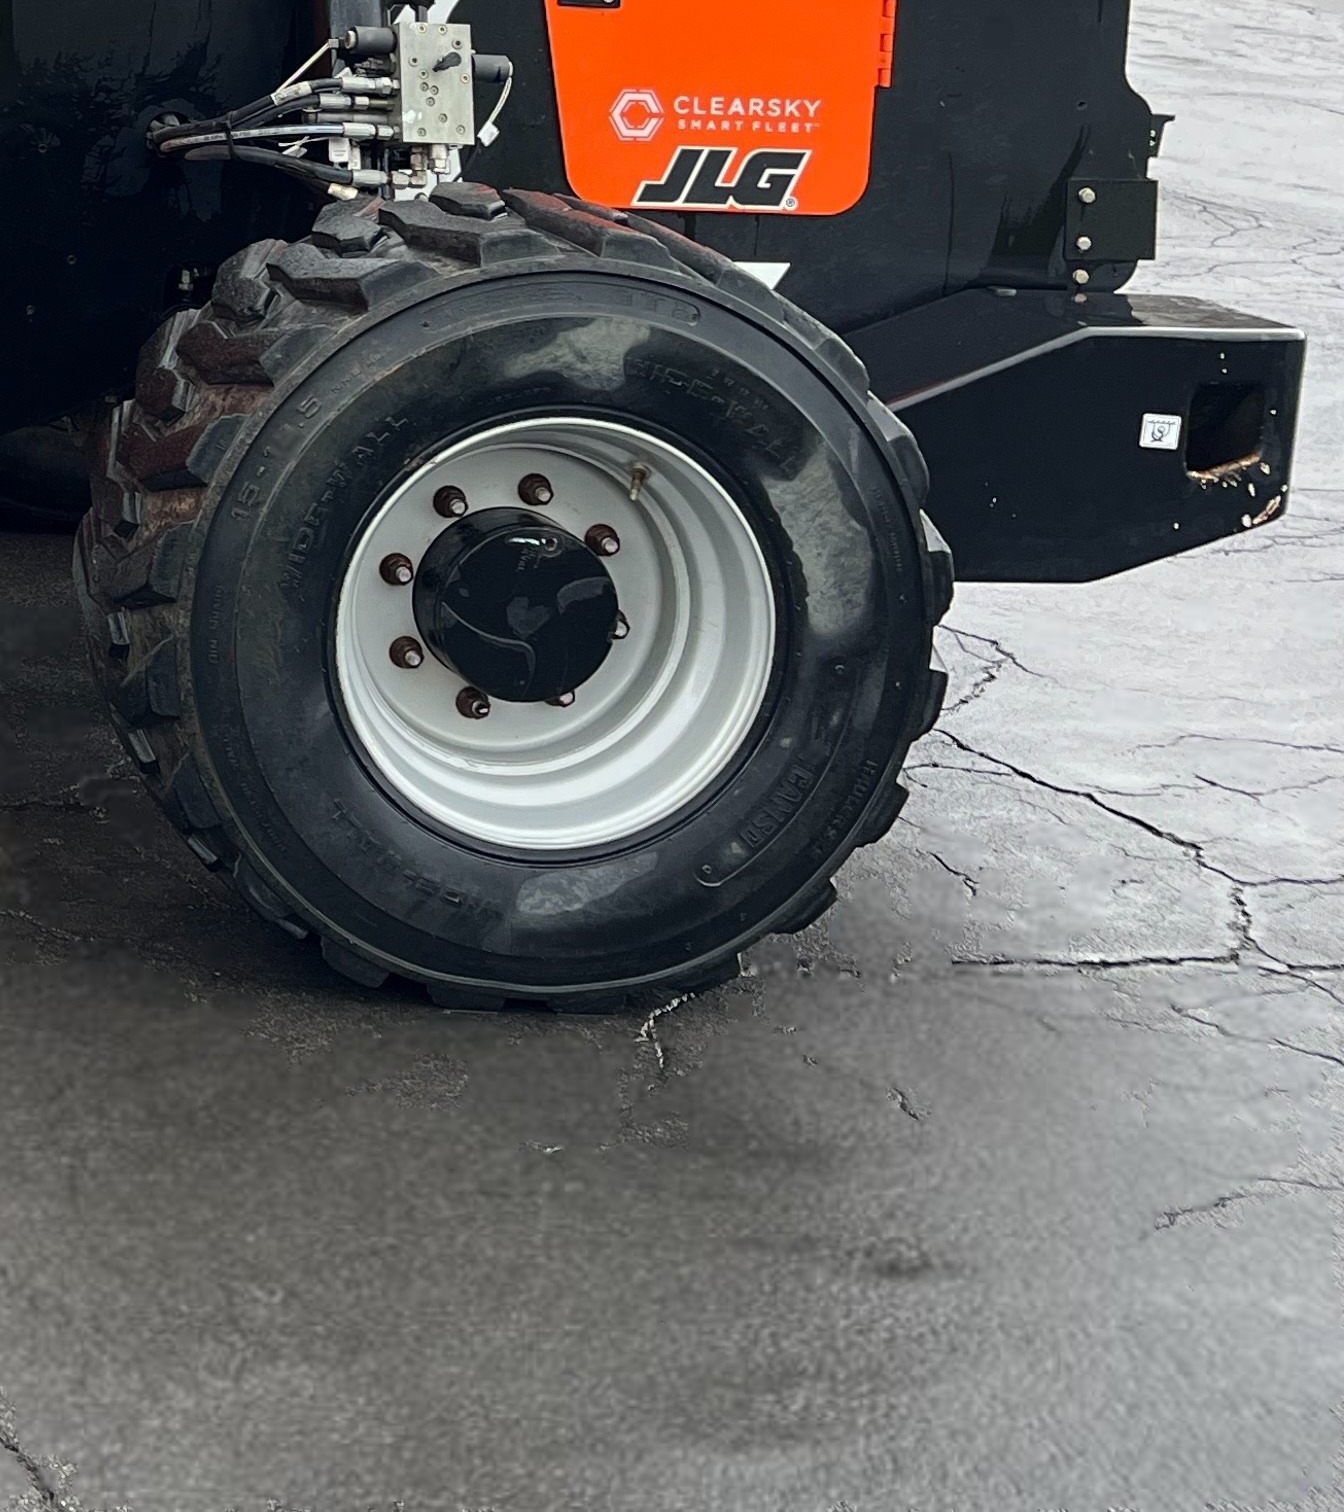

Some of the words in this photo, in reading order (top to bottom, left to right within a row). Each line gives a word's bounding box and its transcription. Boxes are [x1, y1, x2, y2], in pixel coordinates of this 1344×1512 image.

[673, 96, 822, 118] CLEARSKY
[677, 119, 744, 132] SMART
[226, 387, 327, 525] 15-.5
